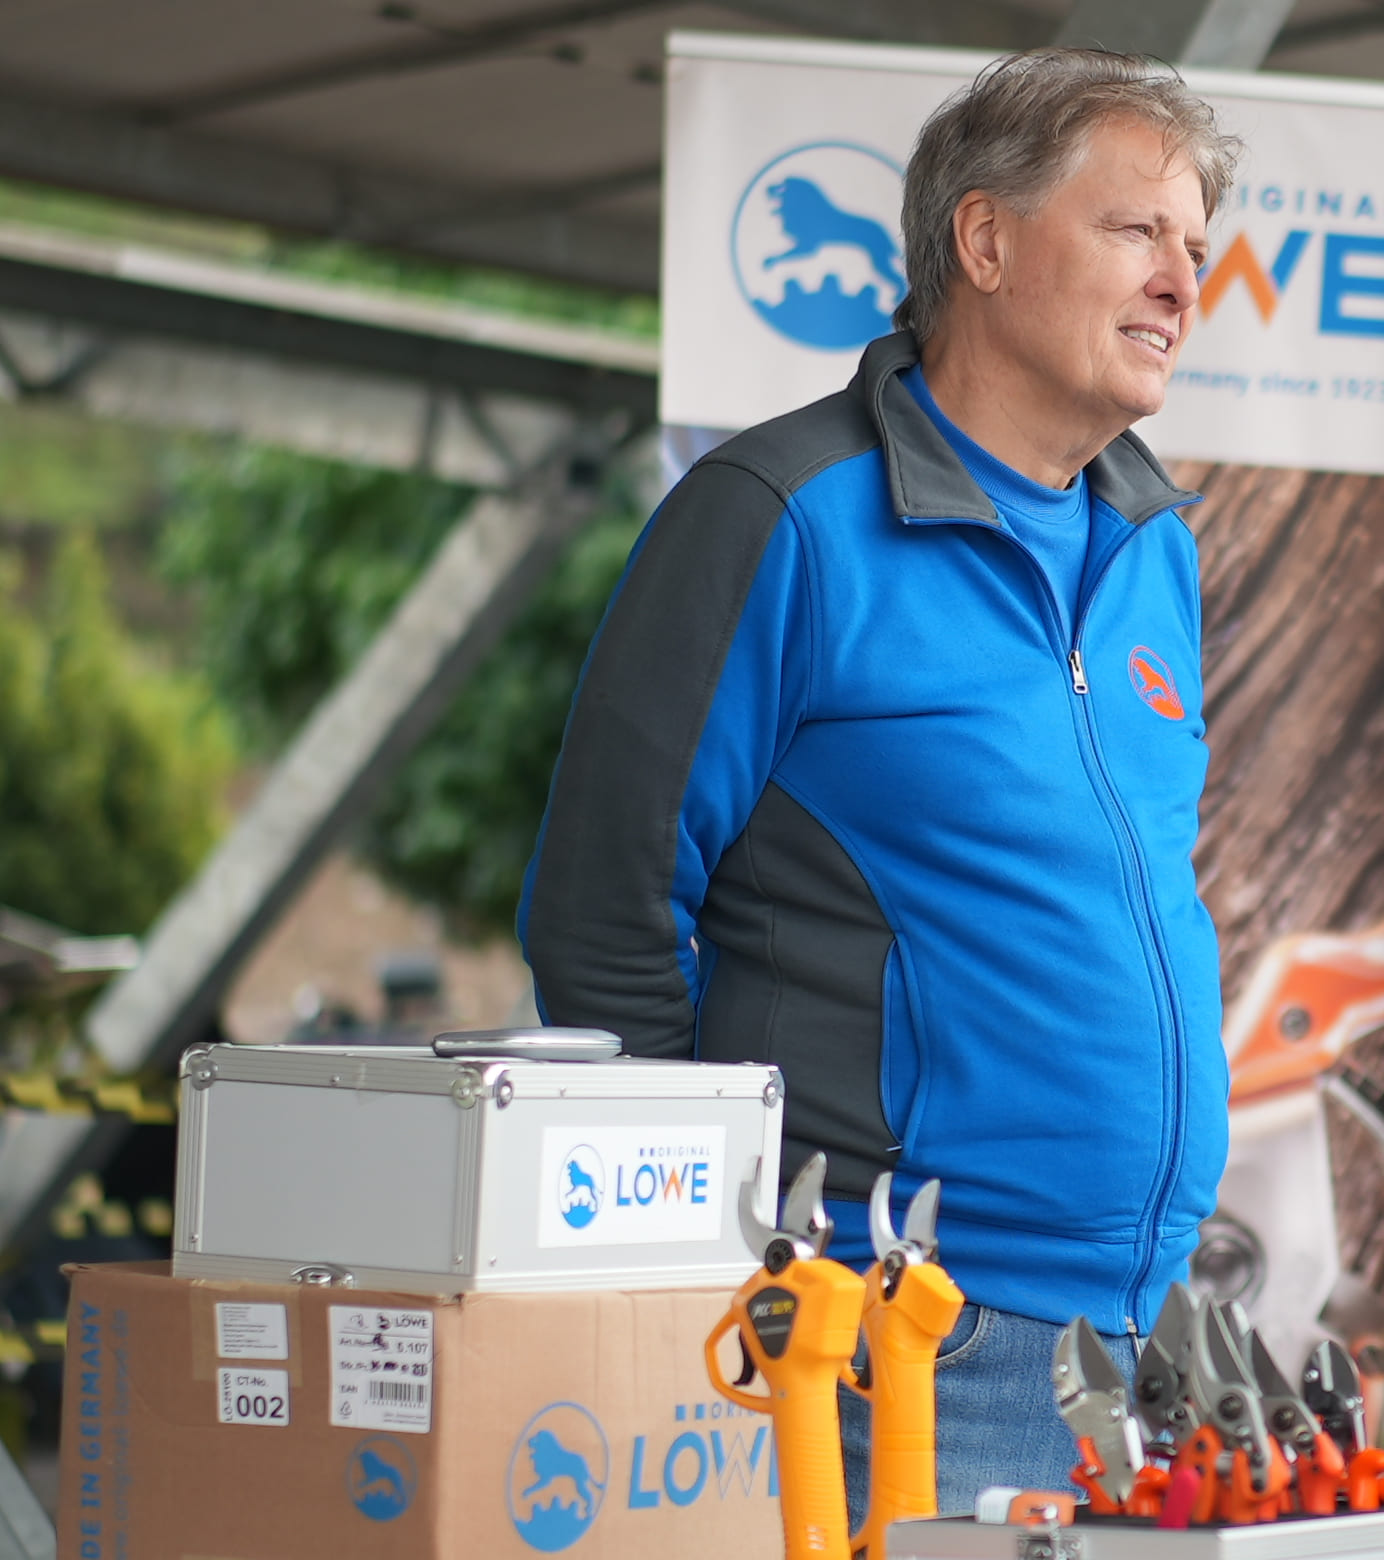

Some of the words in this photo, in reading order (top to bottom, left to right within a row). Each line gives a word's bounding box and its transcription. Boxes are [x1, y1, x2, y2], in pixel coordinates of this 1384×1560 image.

[658, 1147, 710, 1158] ORIGINAL
[80, 1302, 101, 1461] GERMANY
[236, 1395, 285, 1419] 002
[80, 1473, 101, 1508] IN
